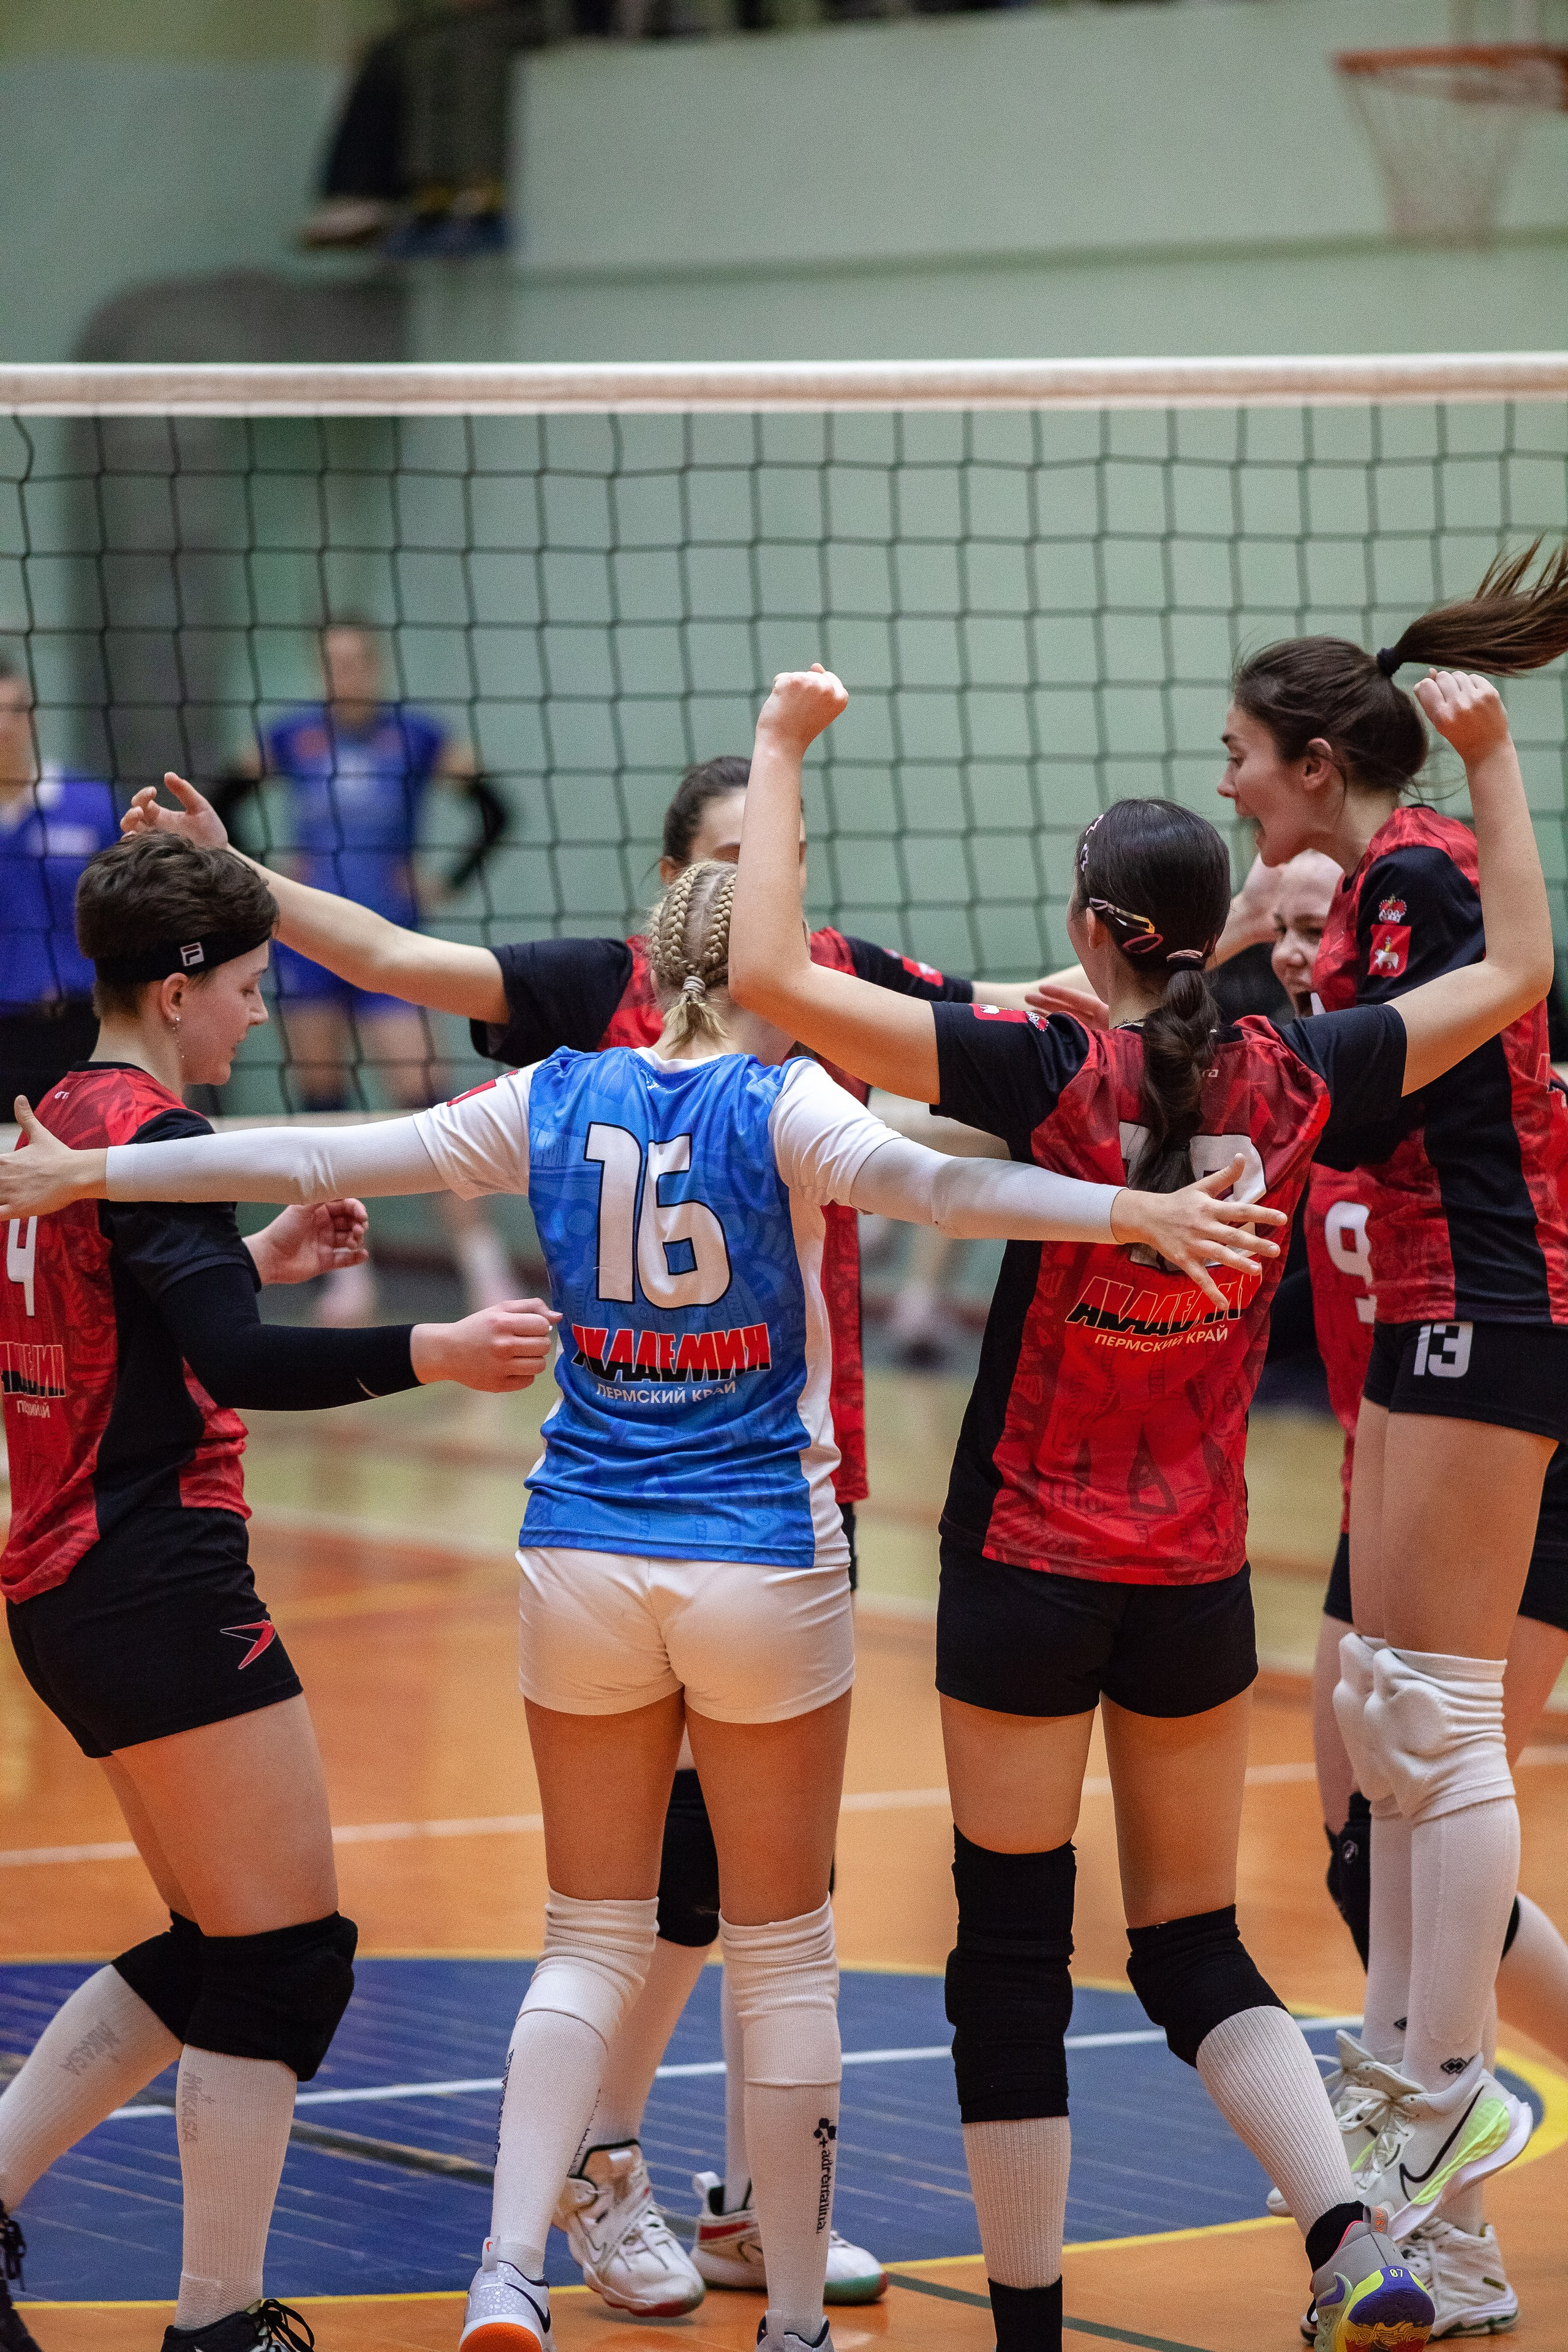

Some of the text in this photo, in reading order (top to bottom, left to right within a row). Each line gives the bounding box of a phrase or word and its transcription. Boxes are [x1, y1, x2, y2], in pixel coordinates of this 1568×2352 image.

[583, 1121, 733, 1310] 16
[7, 1215, 37, 1318] 4
[571, 1322, 772, 1384] АКАДЕМИЯ
[1095, 1324, 1228, 1352] ПЕРМСКИЙ КРАЙ
[1413, 1321, 1474, 1378] 13
[596, 1382, 686, 1404] ПЕРМСКИЙ
